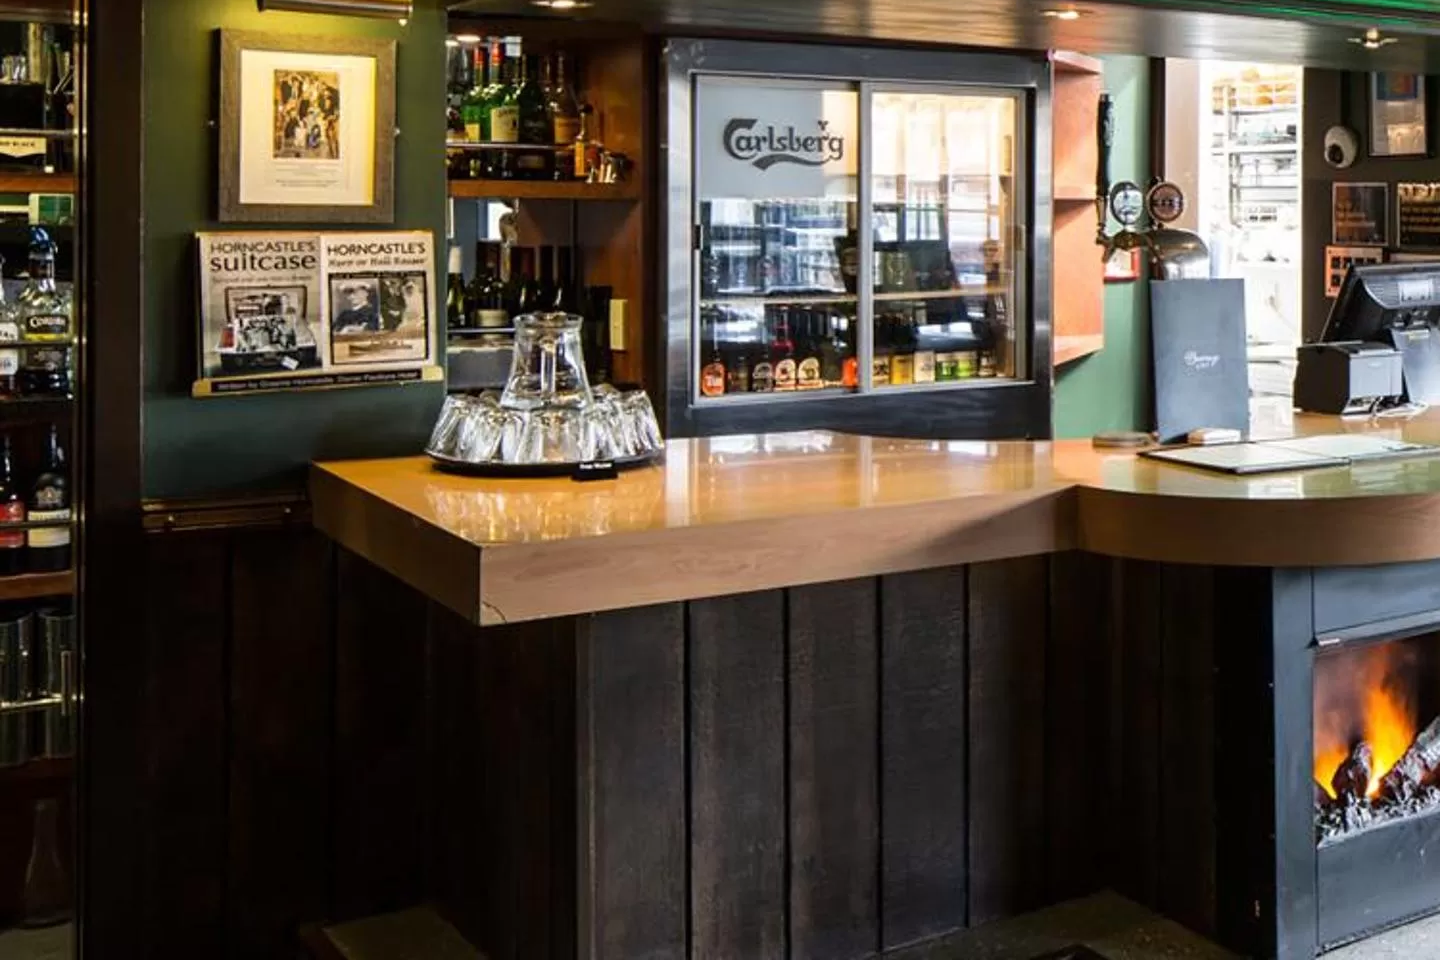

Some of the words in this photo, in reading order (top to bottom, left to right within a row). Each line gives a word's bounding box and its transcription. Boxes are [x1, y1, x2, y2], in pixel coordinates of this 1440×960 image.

[722, 117, 844, 164] Carlsberg
[211, 240, 316, 254] HORNCASTLE'S
[327, 242, 426, 256] HORNCASTLE'S
[210, 252, 317, 272] suitcase
